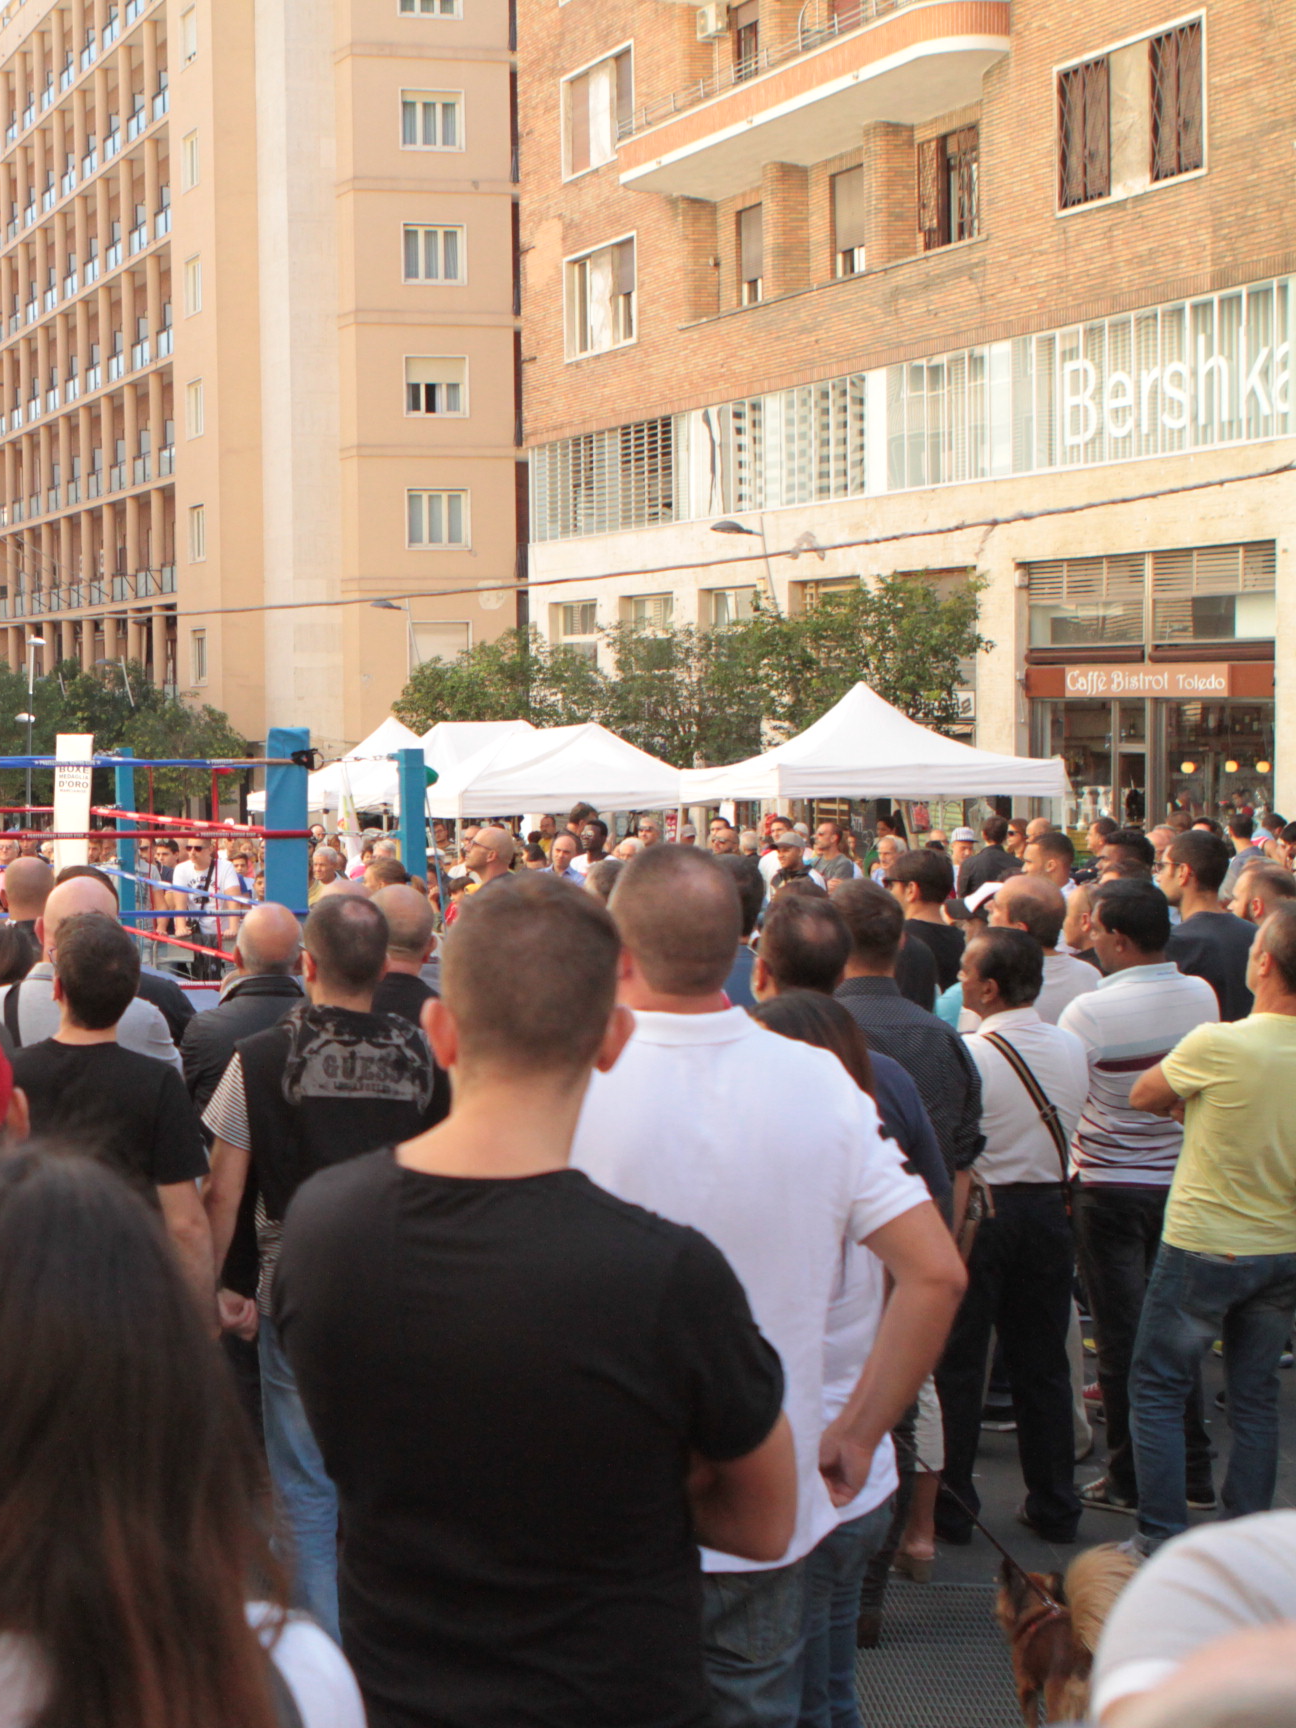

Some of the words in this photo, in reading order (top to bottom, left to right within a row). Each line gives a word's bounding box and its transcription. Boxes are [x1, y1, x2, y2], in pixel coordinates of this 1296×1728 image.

[1066, 670, 1107, 695] Caffè
[1176, 674, 1226, 691] Toledo
[59, 766, 89, 774] BOXE
[58, 781, 89, 789] D'ORO
